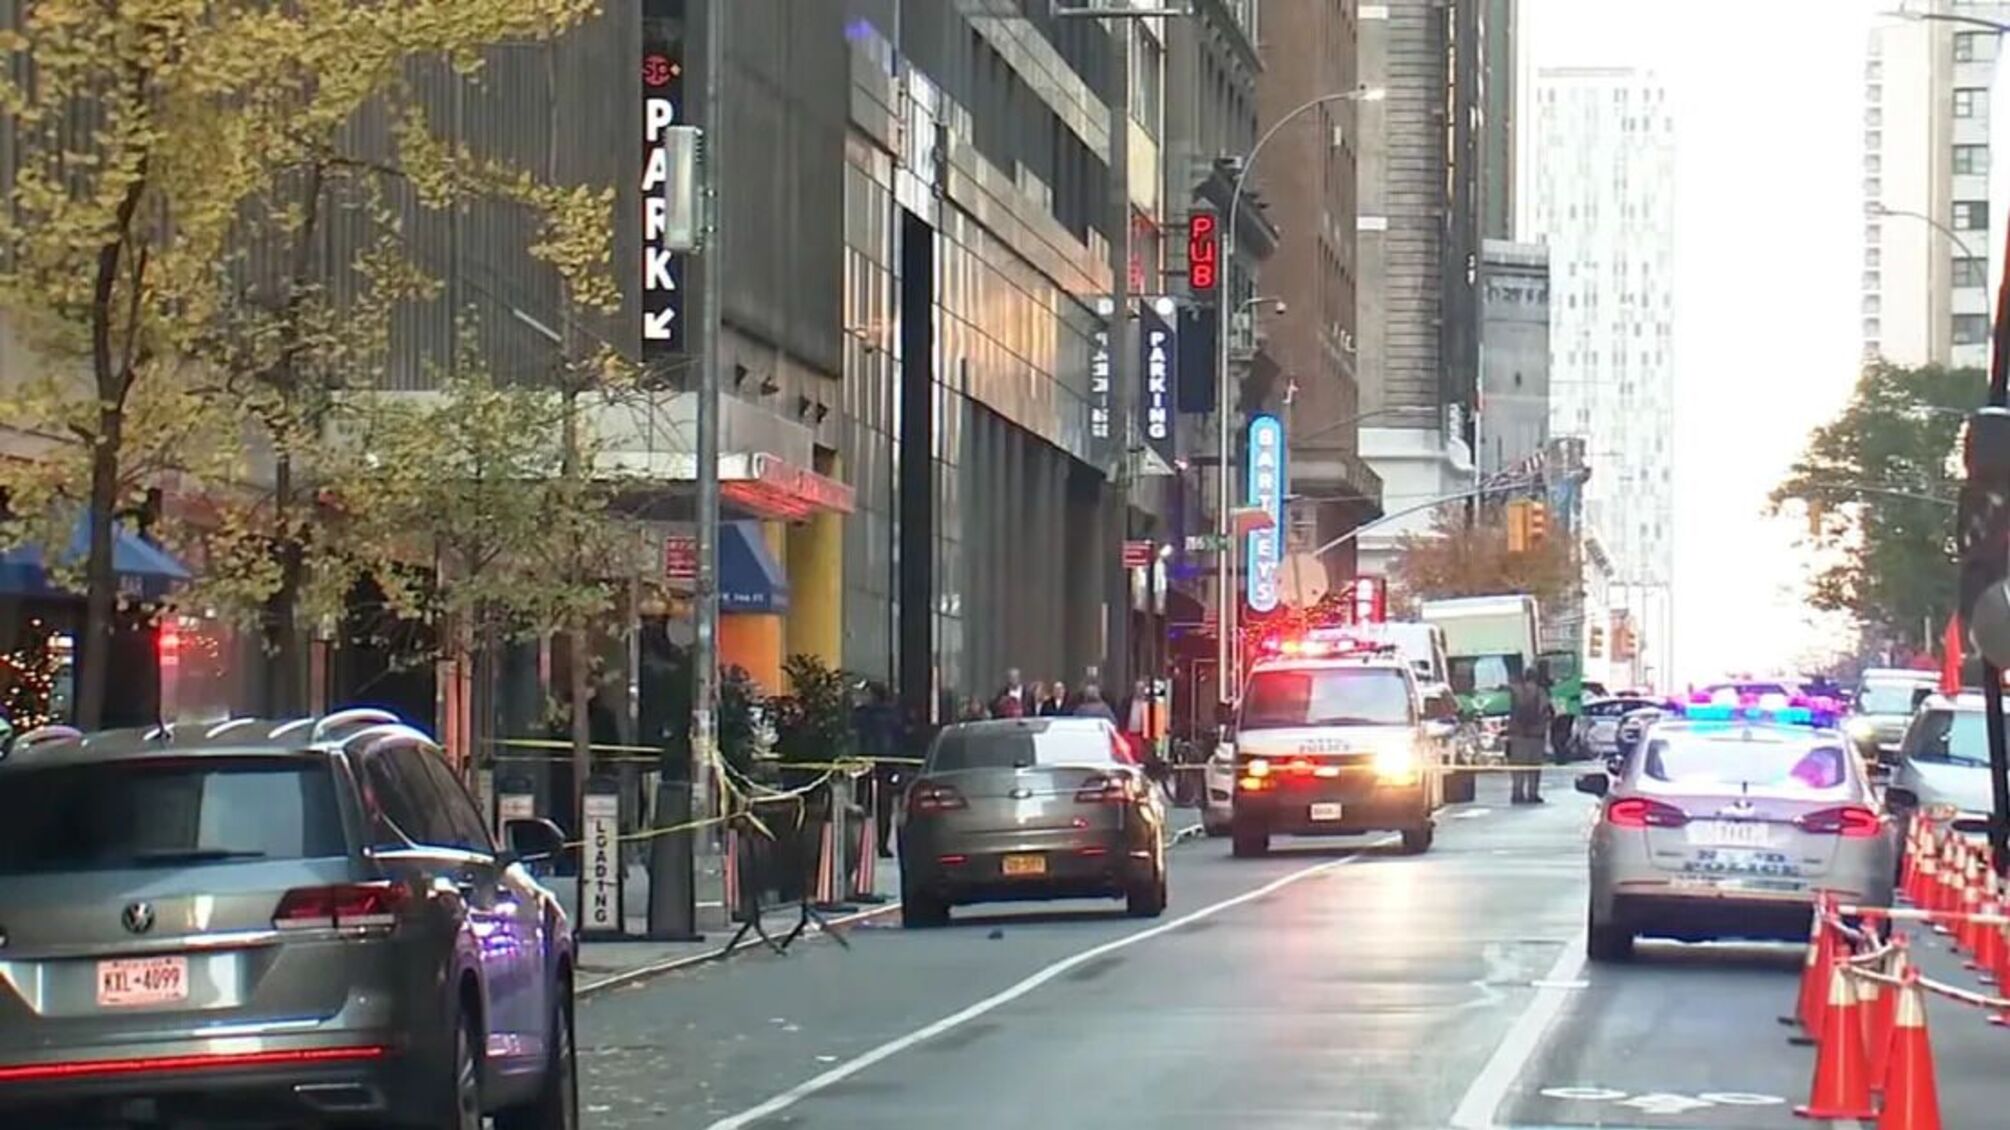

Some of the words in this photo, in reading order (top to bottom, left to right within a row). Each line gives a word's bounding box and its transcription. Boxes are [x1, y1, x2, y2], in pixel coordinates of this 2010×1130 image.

[642, 98, 676, 289] PARK
[1191, 217, 1213, 287] PUB
[1149, 331, 1167, 438] PARKING
[1257, 427, 1276, 600] BARTEYS
[594, 820, 608, 923] LOADING
